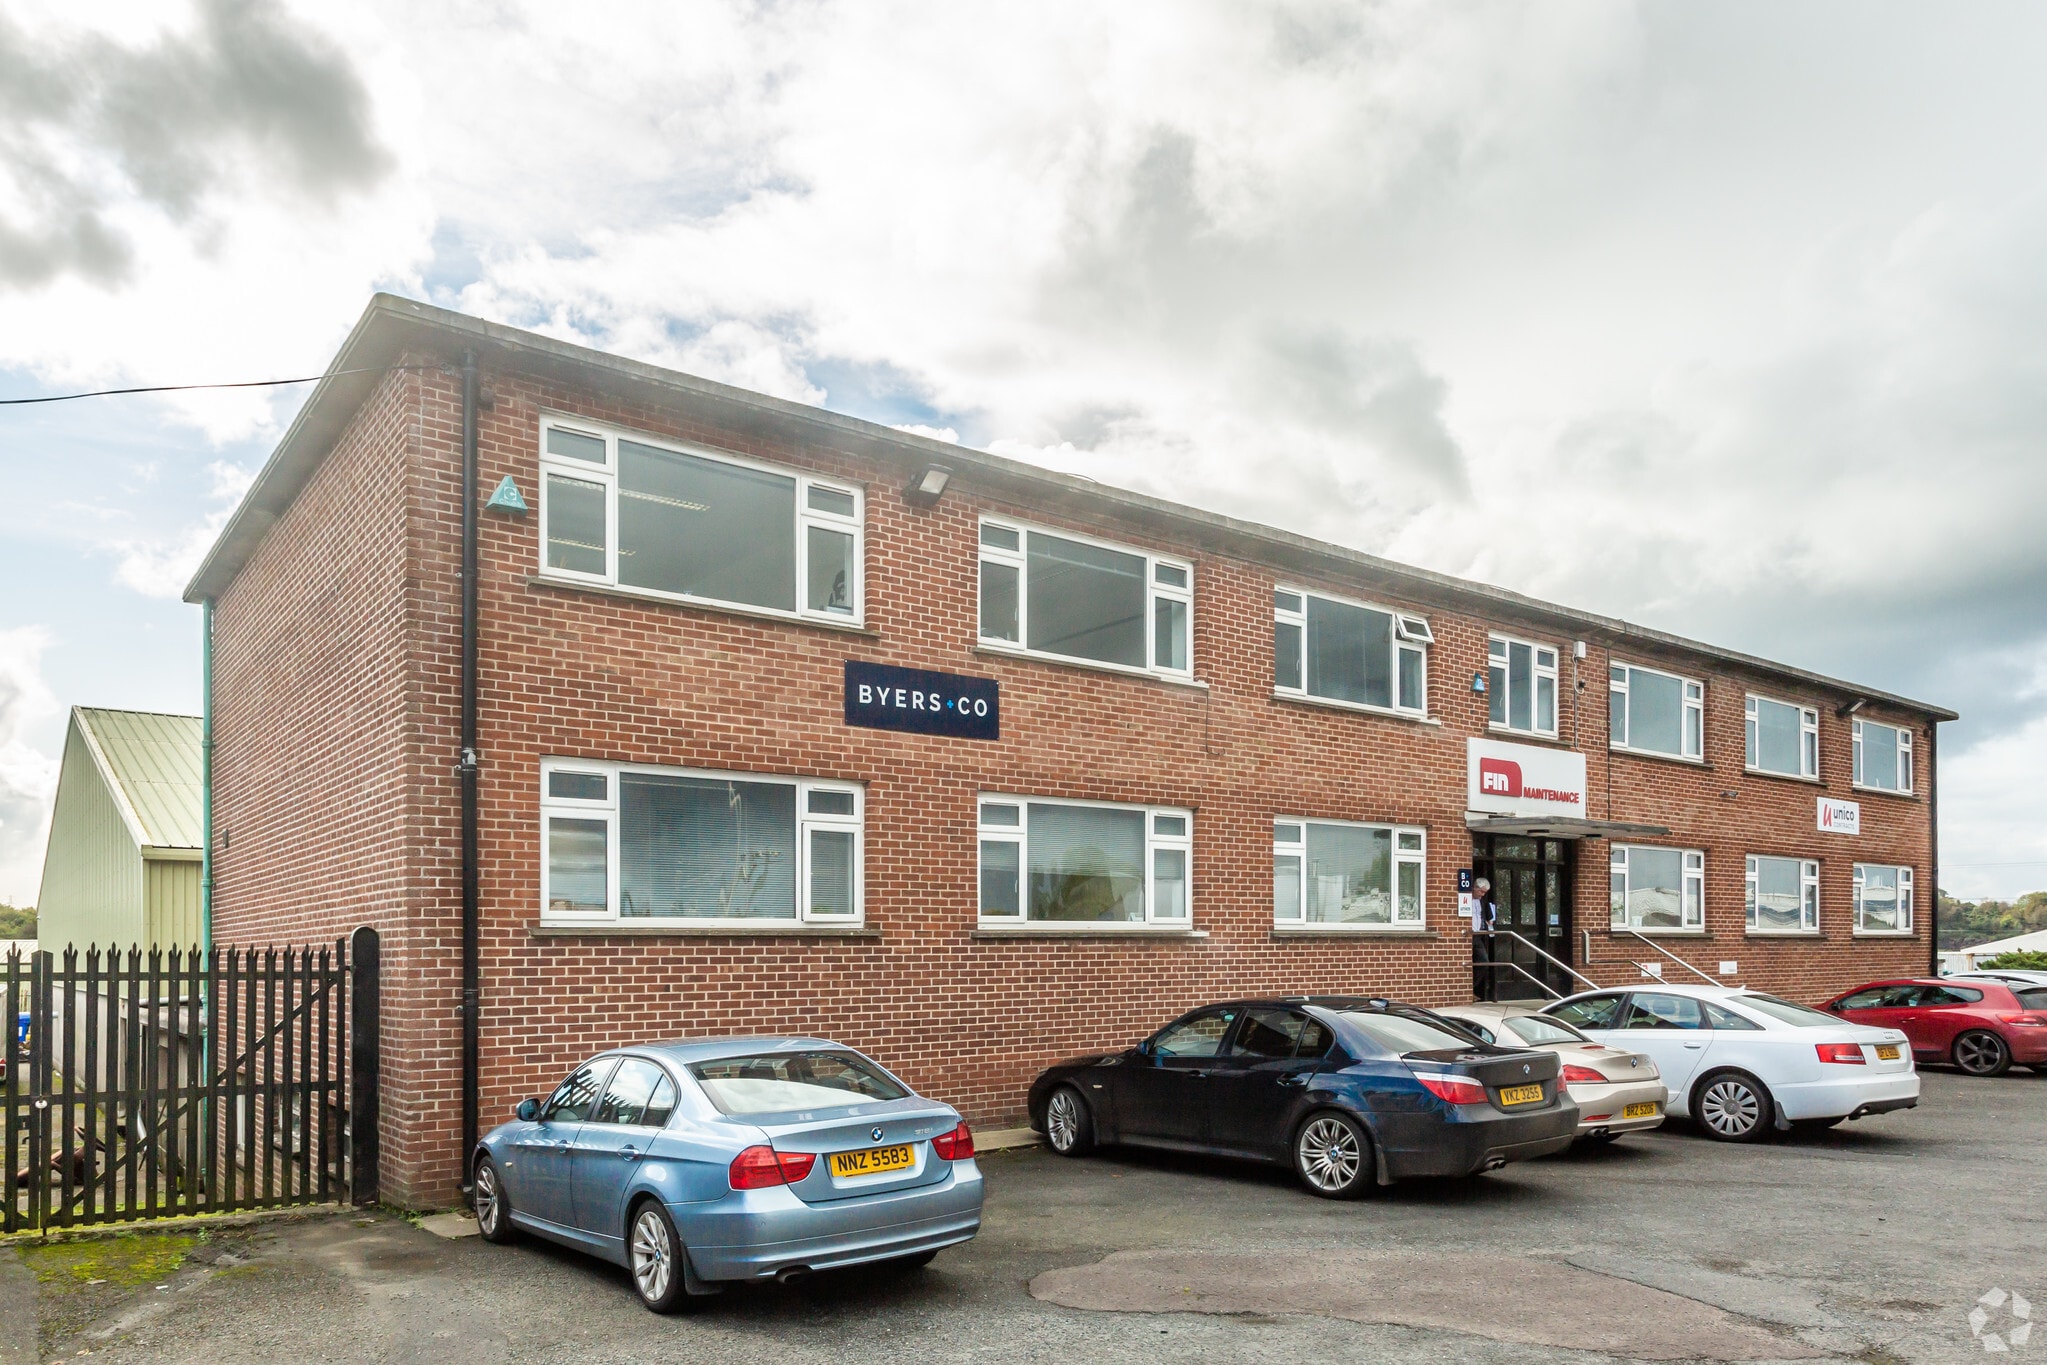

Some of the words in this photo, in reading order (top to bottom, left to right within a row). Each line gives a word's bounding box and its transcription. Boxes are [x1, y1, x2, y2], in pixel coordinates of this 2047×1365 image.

[1523, 786, 1580, 804] MAINTENANCE
[1833, 805, 1855, 821] unico
[1461, 880, 1470, 888] CO
[1503, 1089, 1520, 1102] VKZ
[1520, 1086, 1540, 1100] 3255
[837, 1152, 868, 1172] NNZ
[871, 1147, 909, 1167] 5583
